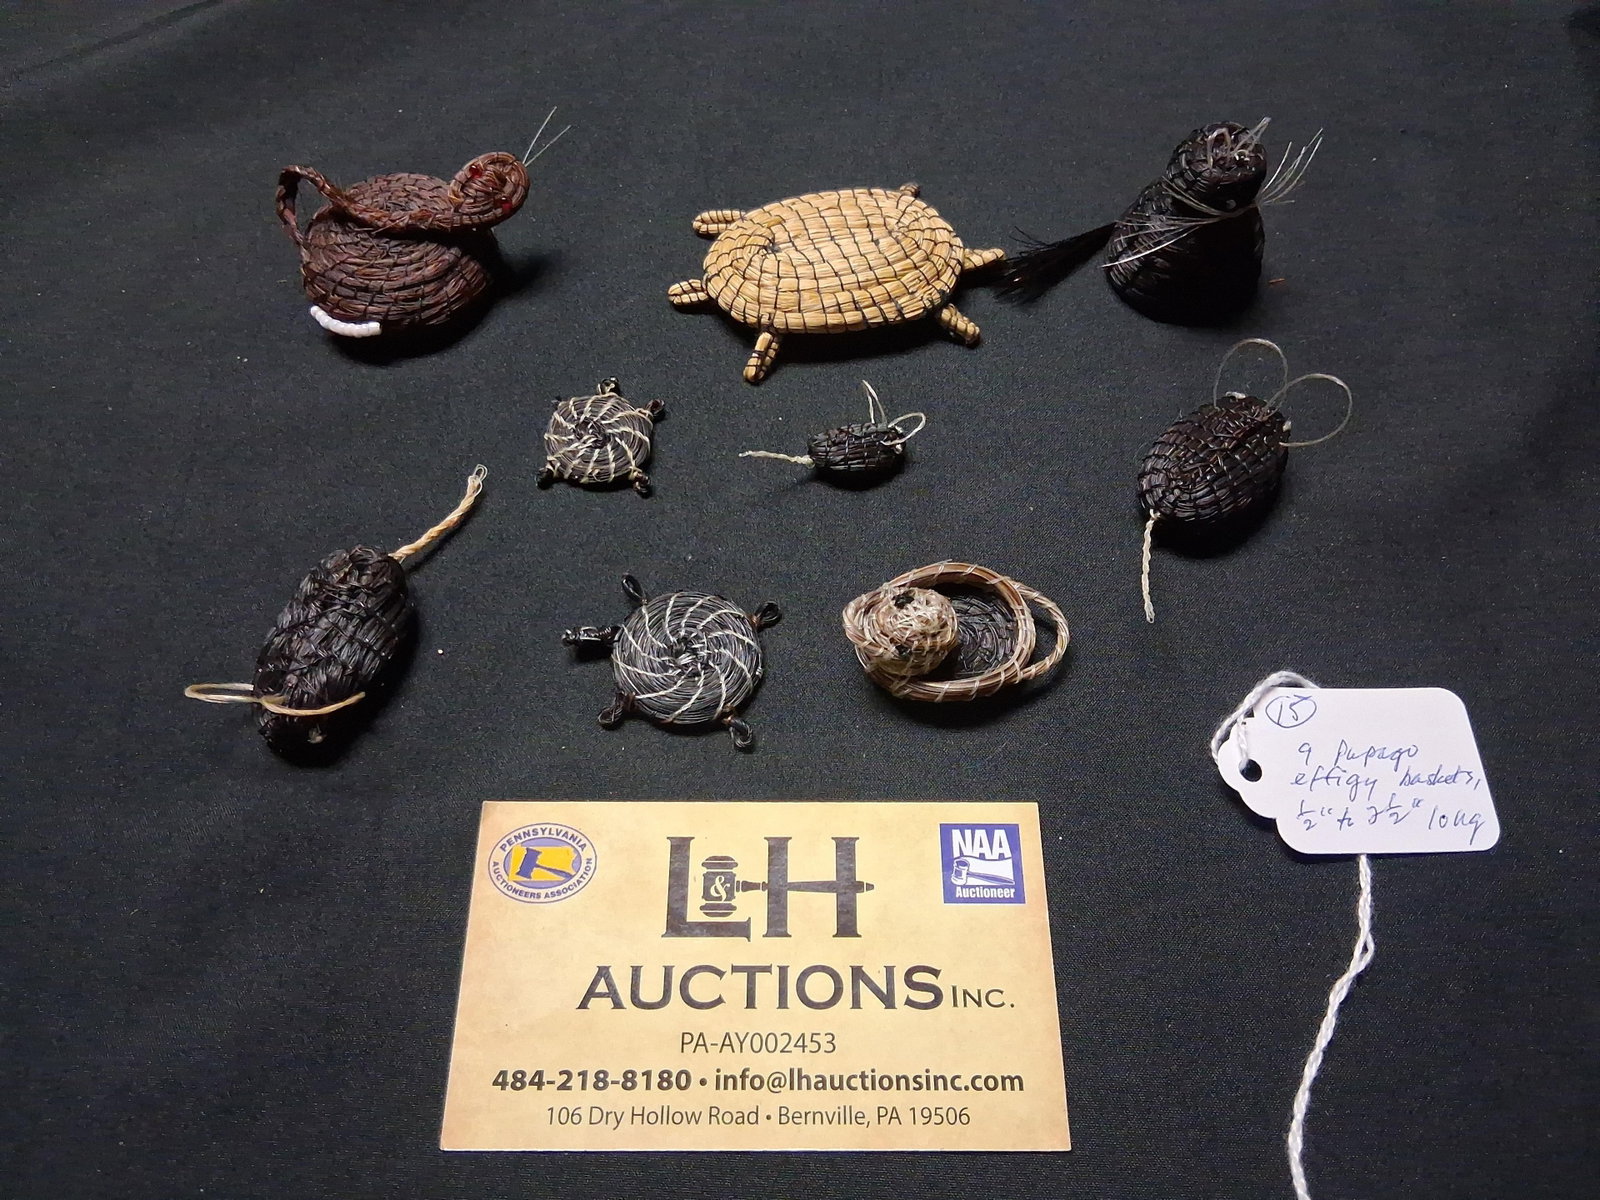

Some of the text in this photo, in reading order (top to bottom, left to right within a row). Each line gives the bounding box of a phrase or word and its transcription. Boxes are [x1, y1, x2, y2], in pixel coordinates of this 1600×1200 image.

[499, 827, 588, 852] PENNSYLVANIA
[951, 829, 1013, 860] NAA
[492, 857, 593, 900] AUCTIONEERS ASSOCIATION
[955, 886, 1016, 898] Auctioneer
[576, 964, 944, 1011] AUCTIONS
[680, 1031, 837, 1054] PA-AY002453
[491, 1067, 1025, 1094] 484-218-8180 info@lhauctionsinc.com
[547, 1105, 971, 1130] 106 Dry Hollow Road Bernville, PA 19506
